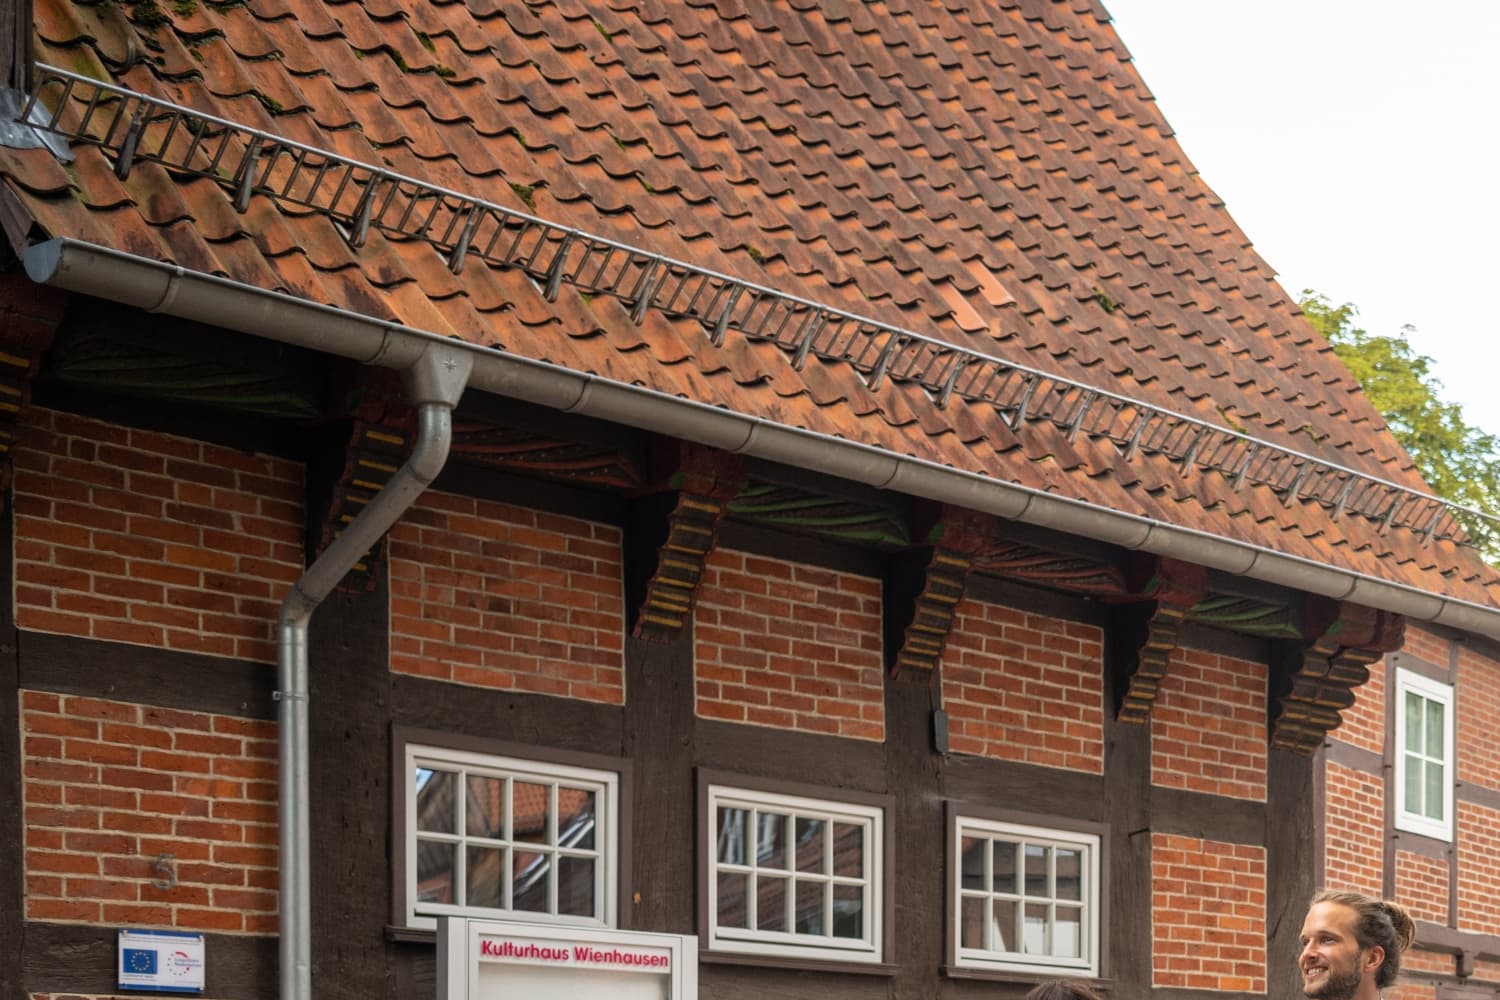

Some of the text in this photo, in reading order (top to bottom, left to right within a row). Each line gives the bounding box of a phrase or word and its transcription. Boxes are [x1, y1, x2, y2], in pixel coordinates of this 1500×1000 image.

[152, 853, 176, 889] 5
[481, 940, 669, 967] Kulturhaus Wienhausen
